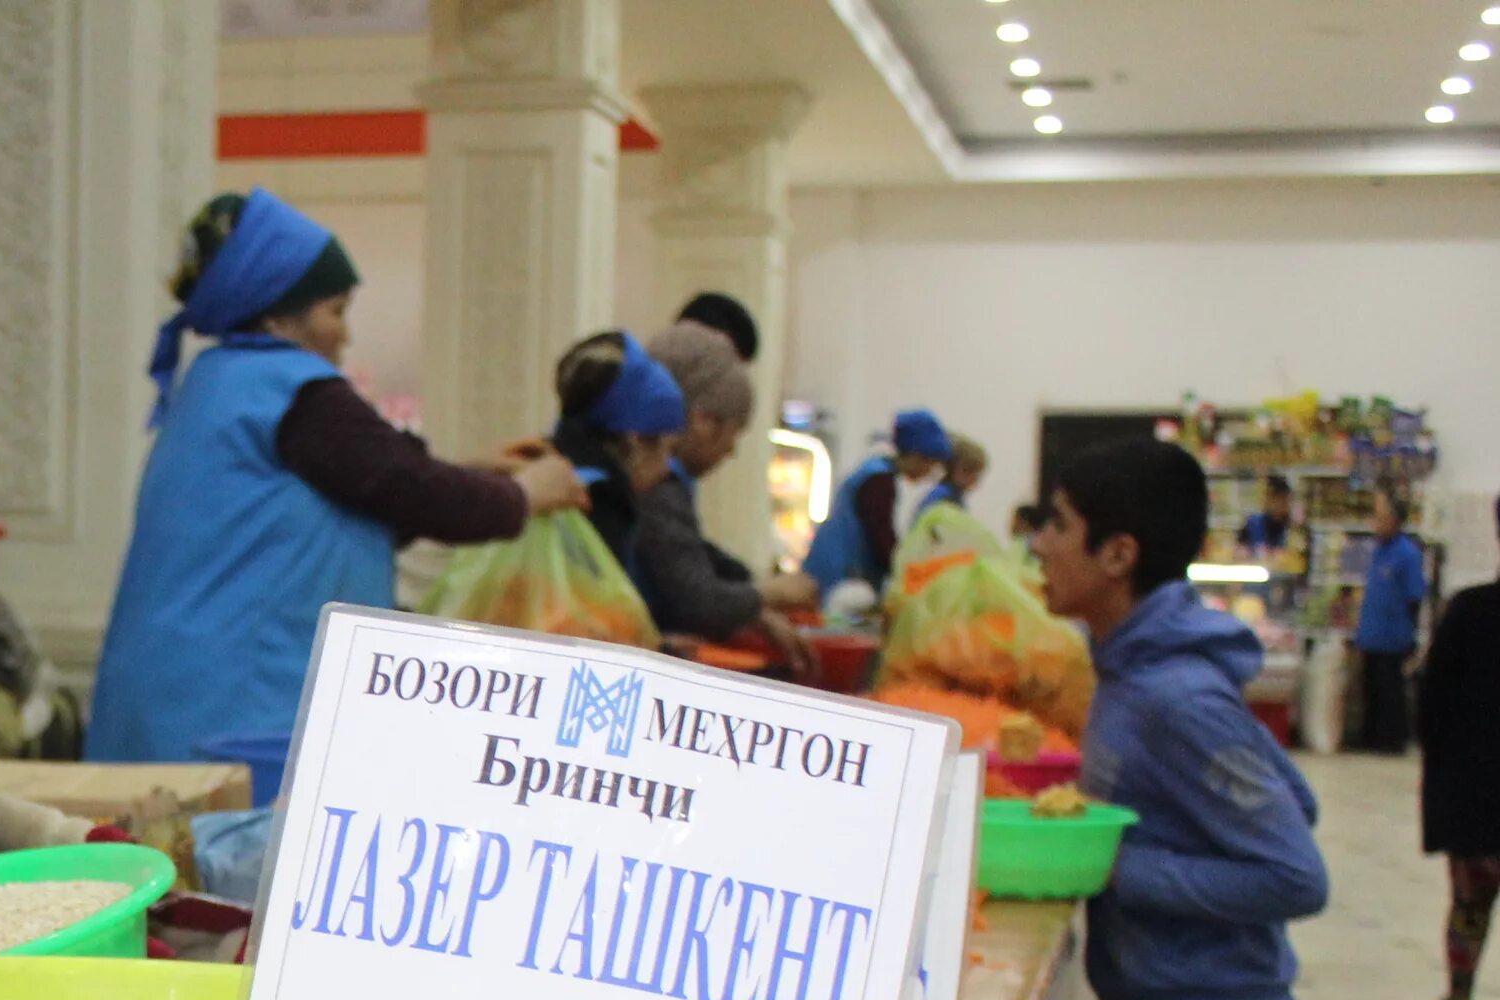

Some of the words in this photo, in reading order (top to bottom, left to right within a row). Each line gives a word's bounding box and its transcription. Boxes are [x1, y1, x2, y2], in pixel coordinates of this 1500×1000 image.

[363, 652, 548, 720] БОЗОРИ
[642, 697, 874, 788] МЕҲРГОН
[291, 805, 511, 959] ЛАЗЕР
